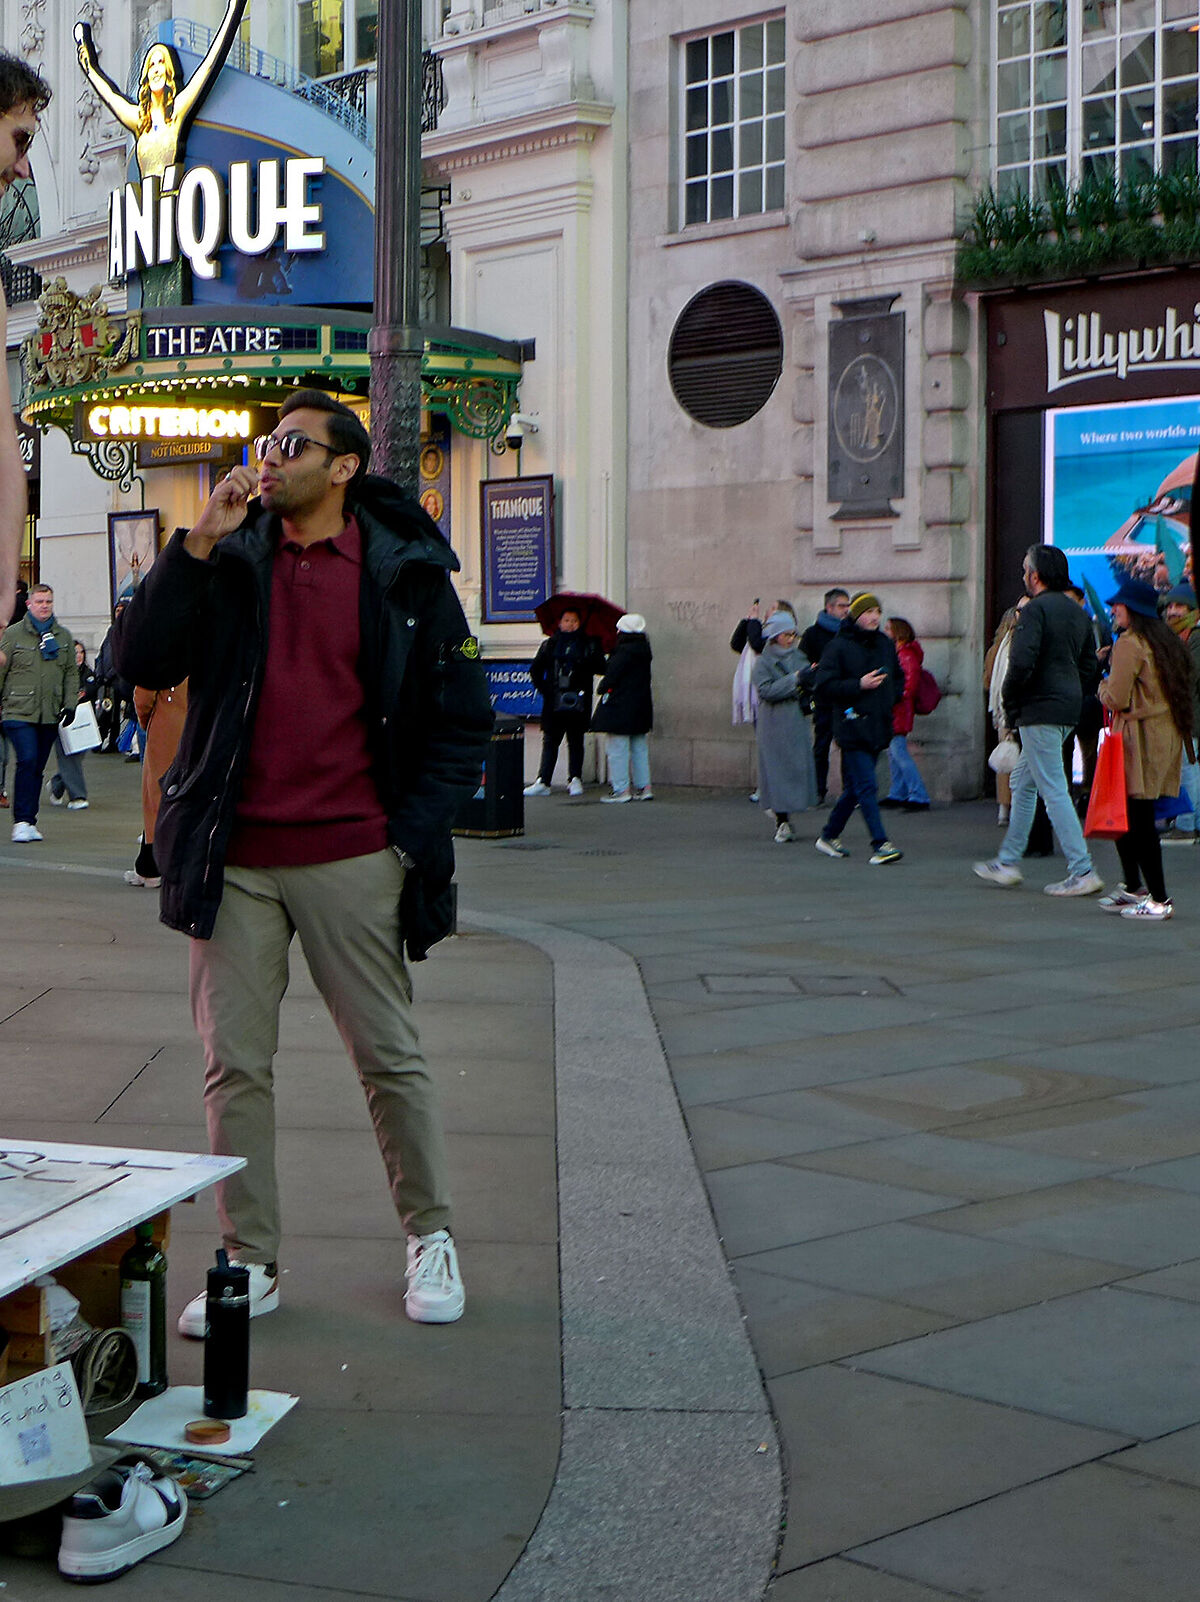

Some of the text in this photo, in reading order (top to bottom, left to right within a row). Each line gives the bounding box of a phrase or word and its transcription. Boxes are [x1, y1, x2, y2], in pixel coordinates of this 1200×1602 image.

[148, 327, 282, 356] THEATRE
[88, 406, 250, 437] CRITERION
[1080, 431, 1118, 444] Where
[1121, 430, 1143, 441] two
[1145, 424, 1186, 439] worlds
[151, 445, 168, 458] NOT
[170, 442, 212, 456] INCLUDED
[490, 671, 532, 682] HAS COM
